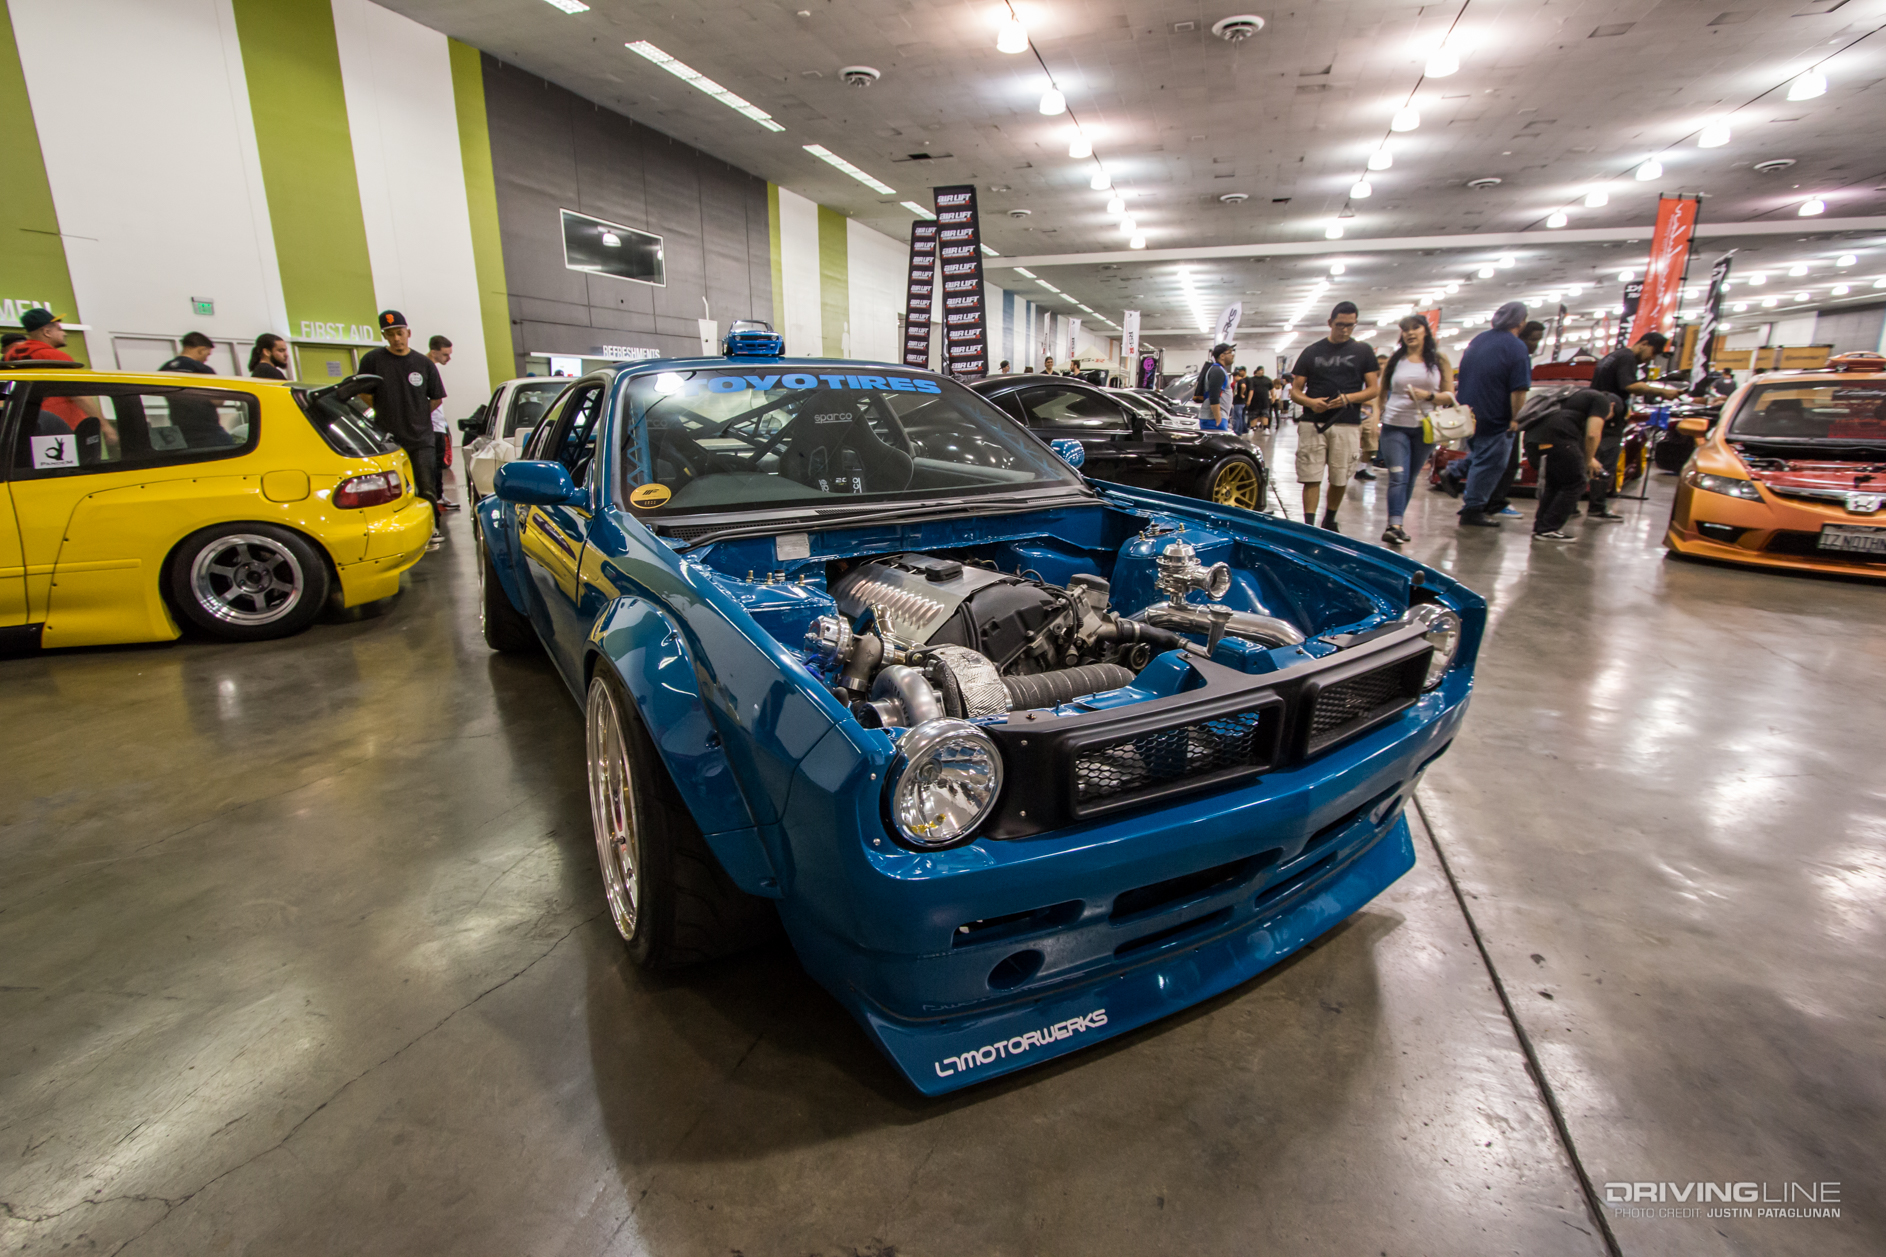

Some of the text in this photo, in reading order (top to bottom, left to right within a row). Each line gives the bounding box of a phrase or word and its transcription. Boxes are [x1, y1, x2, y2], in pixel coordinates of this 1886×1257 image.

[301, 321, 374, 342] FIRST AID
[602, 345, 661, 359] REFRESHMENTS
[683, 373, 942, 396] TOYO TIRES
[814, 411, 853, 424] sparco
